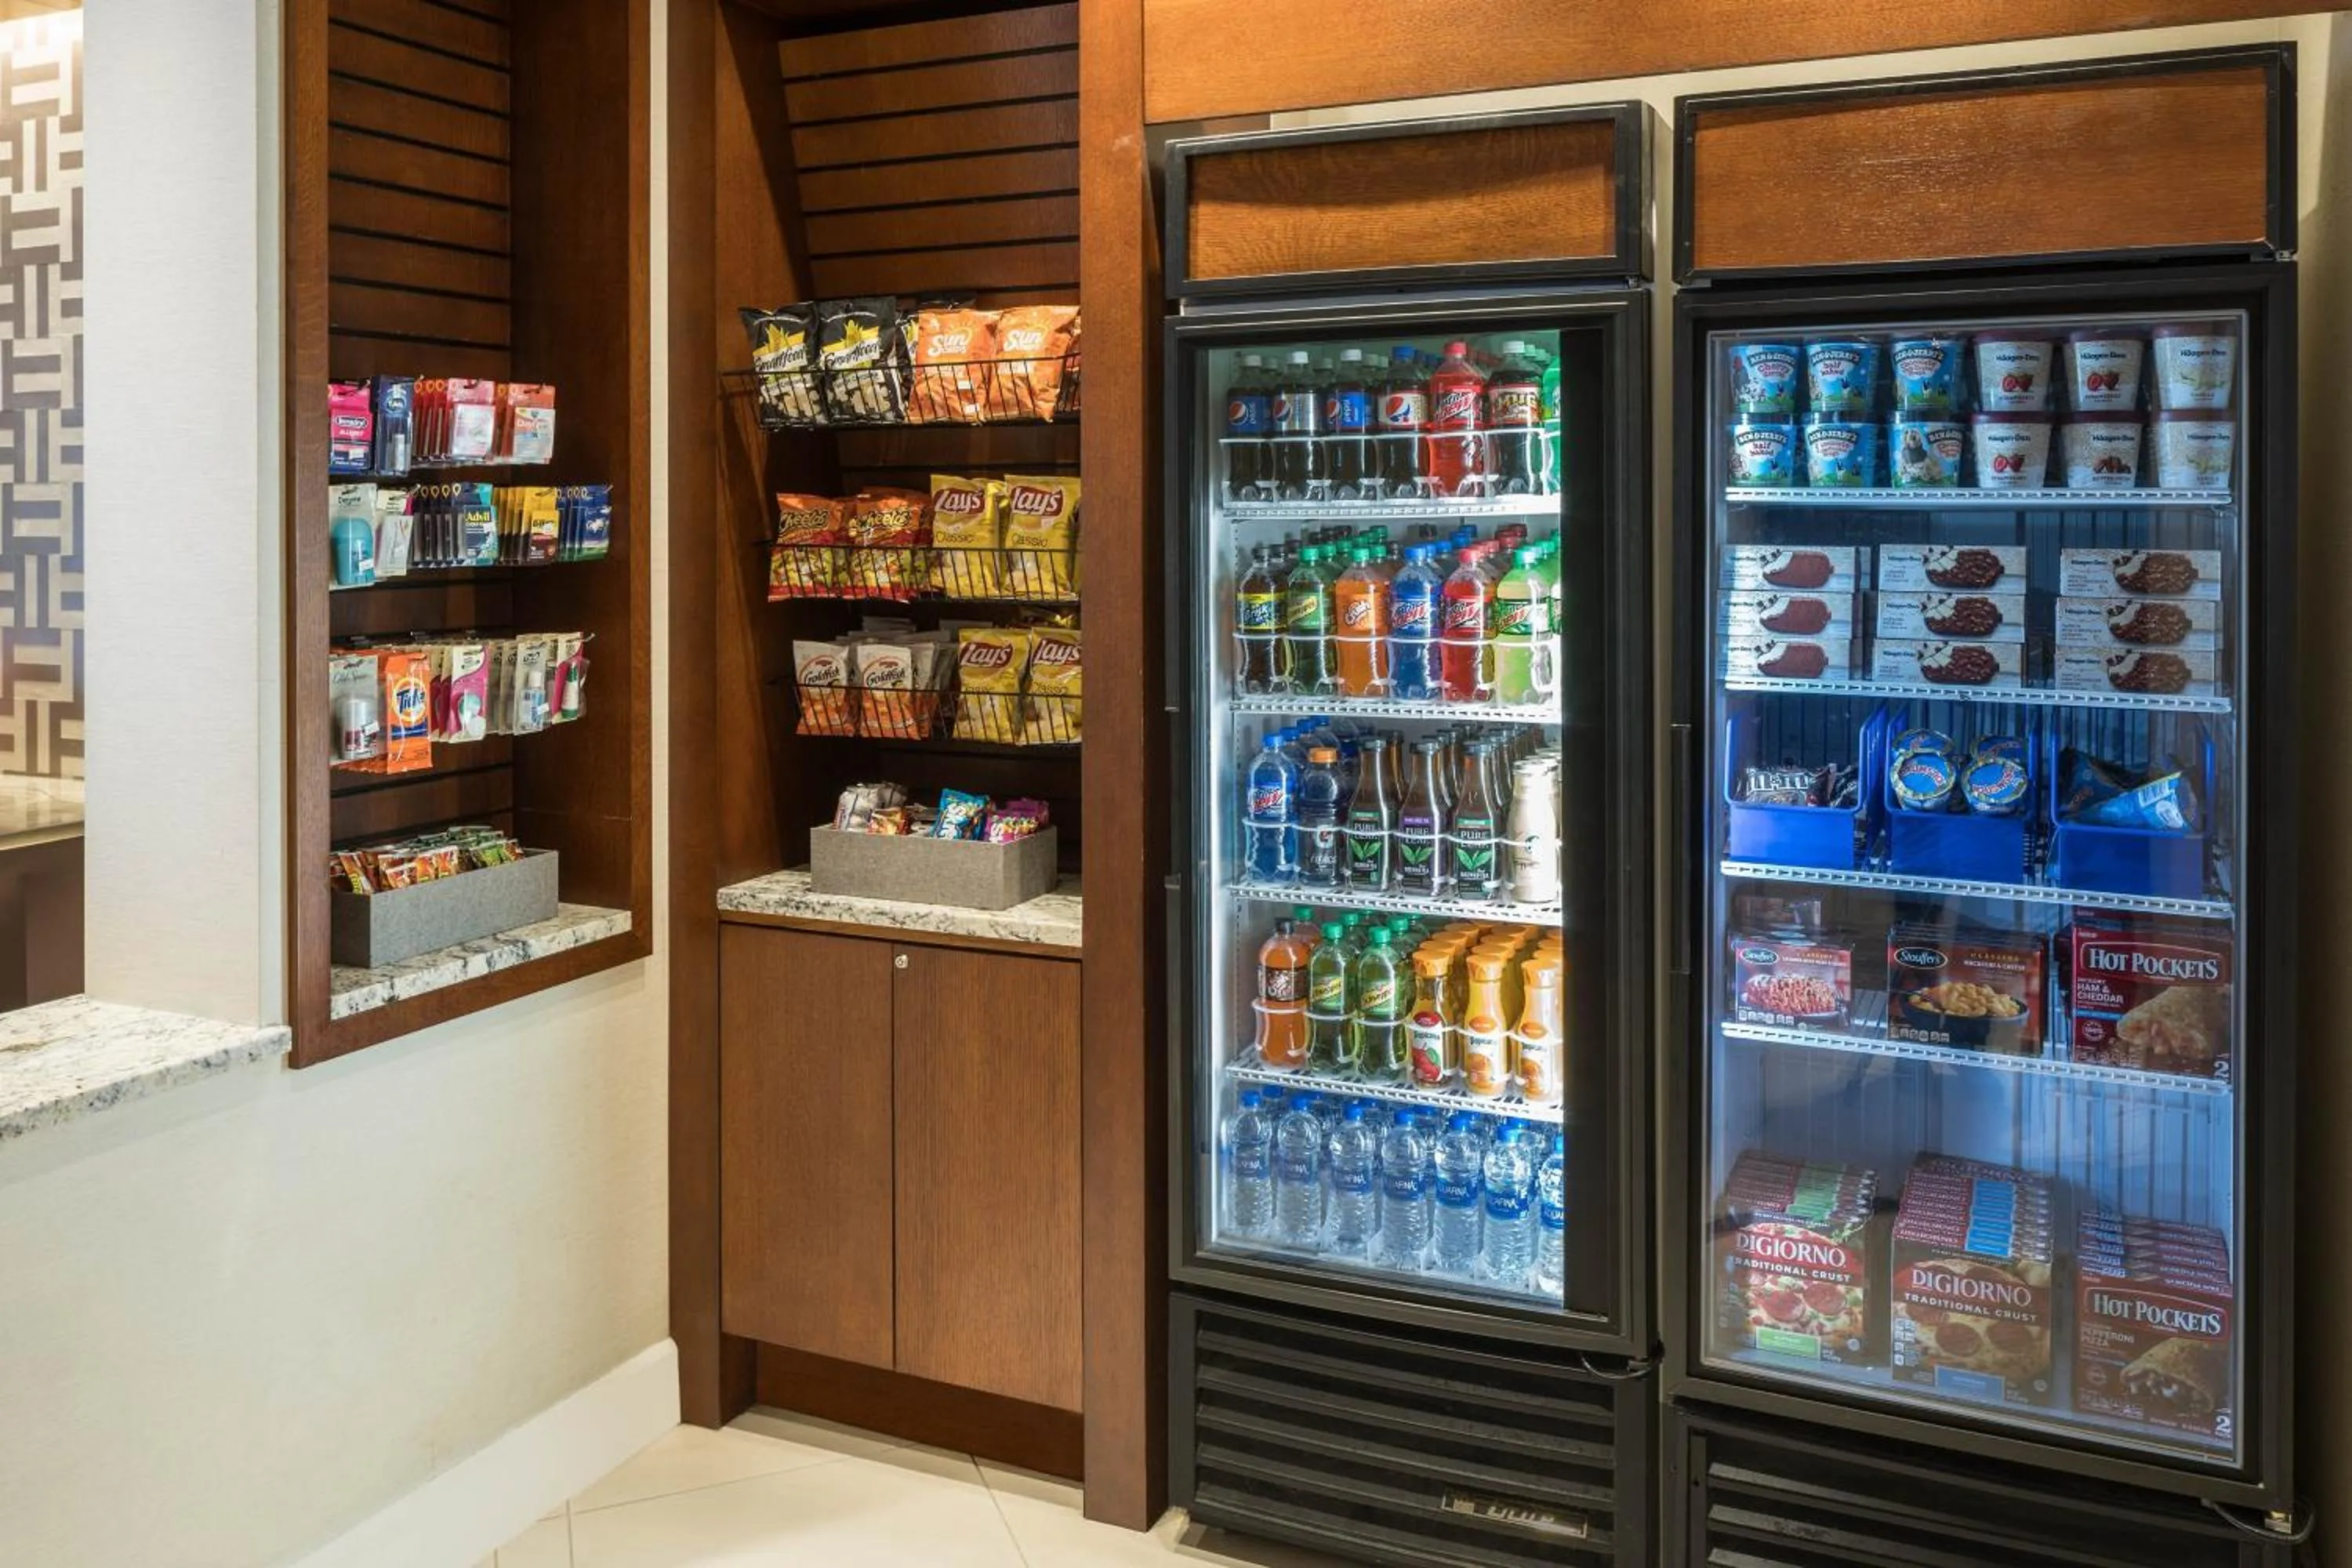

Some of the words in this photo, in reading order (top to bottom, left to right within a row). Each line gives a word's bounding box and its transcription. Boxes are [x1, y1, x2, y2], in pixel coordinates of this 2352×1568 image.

[928, 333, 967, 357] Sun
[1004, 329, 1042, 352] Sun
[934, 489, 984, 514] Lay's
[1011, 487, 1062, 515] Lay's
[465, 511, 490, 521] Advil
[935, 531, 974, 543] Classic
[1012, 533, 1048, 547] Classic
[960, 641, 1012, 666] Lay's
[1033, 639, 1082, 666] Lay's
[1900, 950, 1941, 965] Stouffer's
[2089, 948, 2129, 971] HOT
[2132, 953, 2219, 980] POCKETS
[2078, 982, 2100, 992] HAM
[2078, 991, 2124, 1004] CHEDDAR
[2213, 1061, 2230, 1077] 2
[1811, 1269, 1852, 1283] CRUST
[1904, 1292, 1990, 1316] TRADITIONAL
[1994, 1308, 2038, 1323] CRUST
[2093, 1293, 2133, 1319] HOT
[2135, 1301, 2222, 1336] POCKETS
[2215, 1414, 2231, 1433] 2
